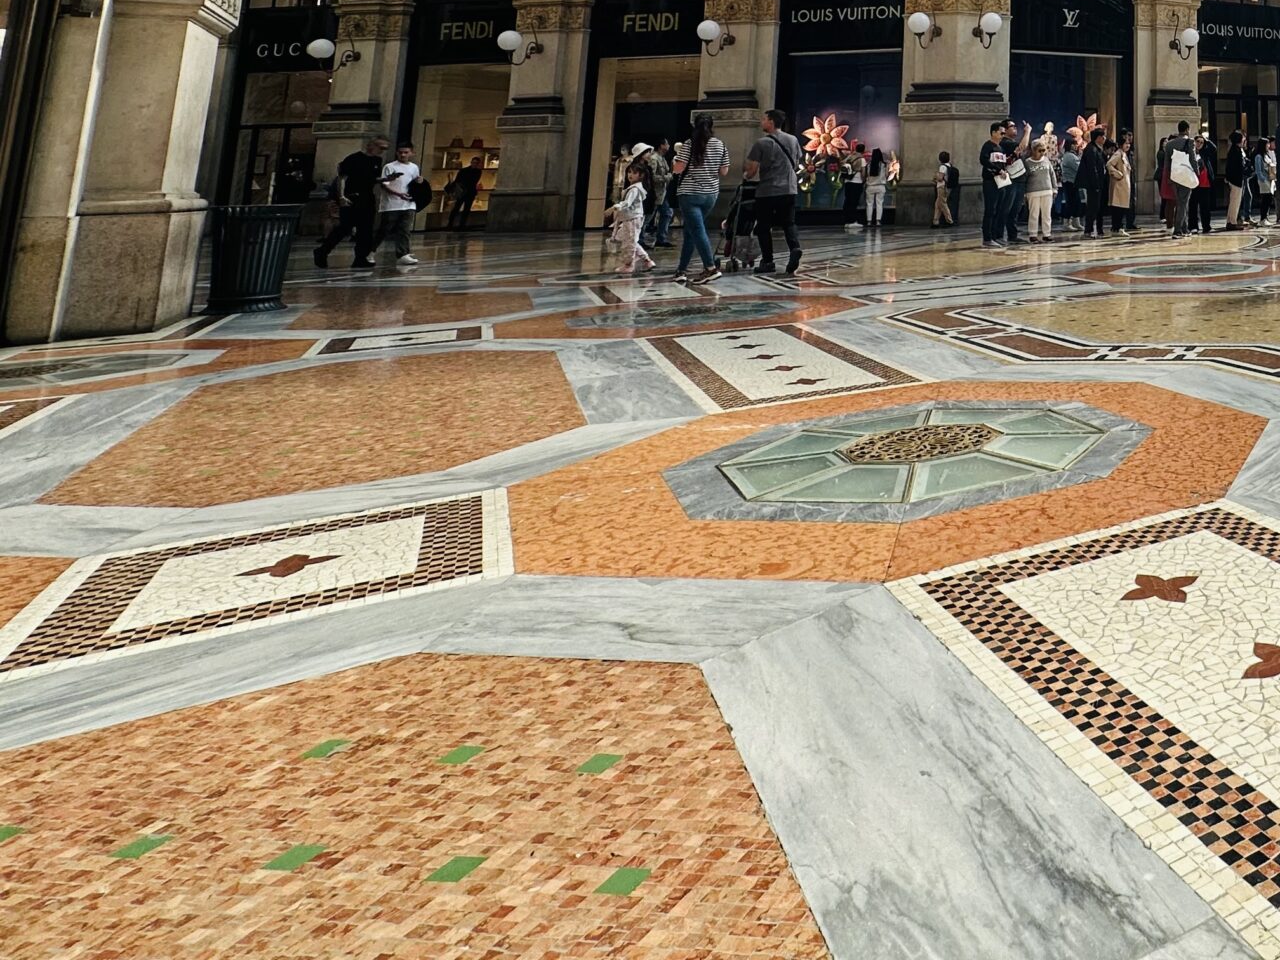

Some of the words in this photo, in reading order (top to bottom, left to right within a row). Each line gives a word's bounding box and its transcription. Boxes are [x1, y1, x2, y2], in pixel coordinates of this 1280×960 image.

[622, 12, 679, 33] FENDI
[791, 8, 833, 23] LOUIS
[837, 5, 901, 21] VUITTON
[440, 20, 494, 41] FENDI
[1201, 23, 1234, 37] LOUIS
[256, 42, 302, 58] GUC
